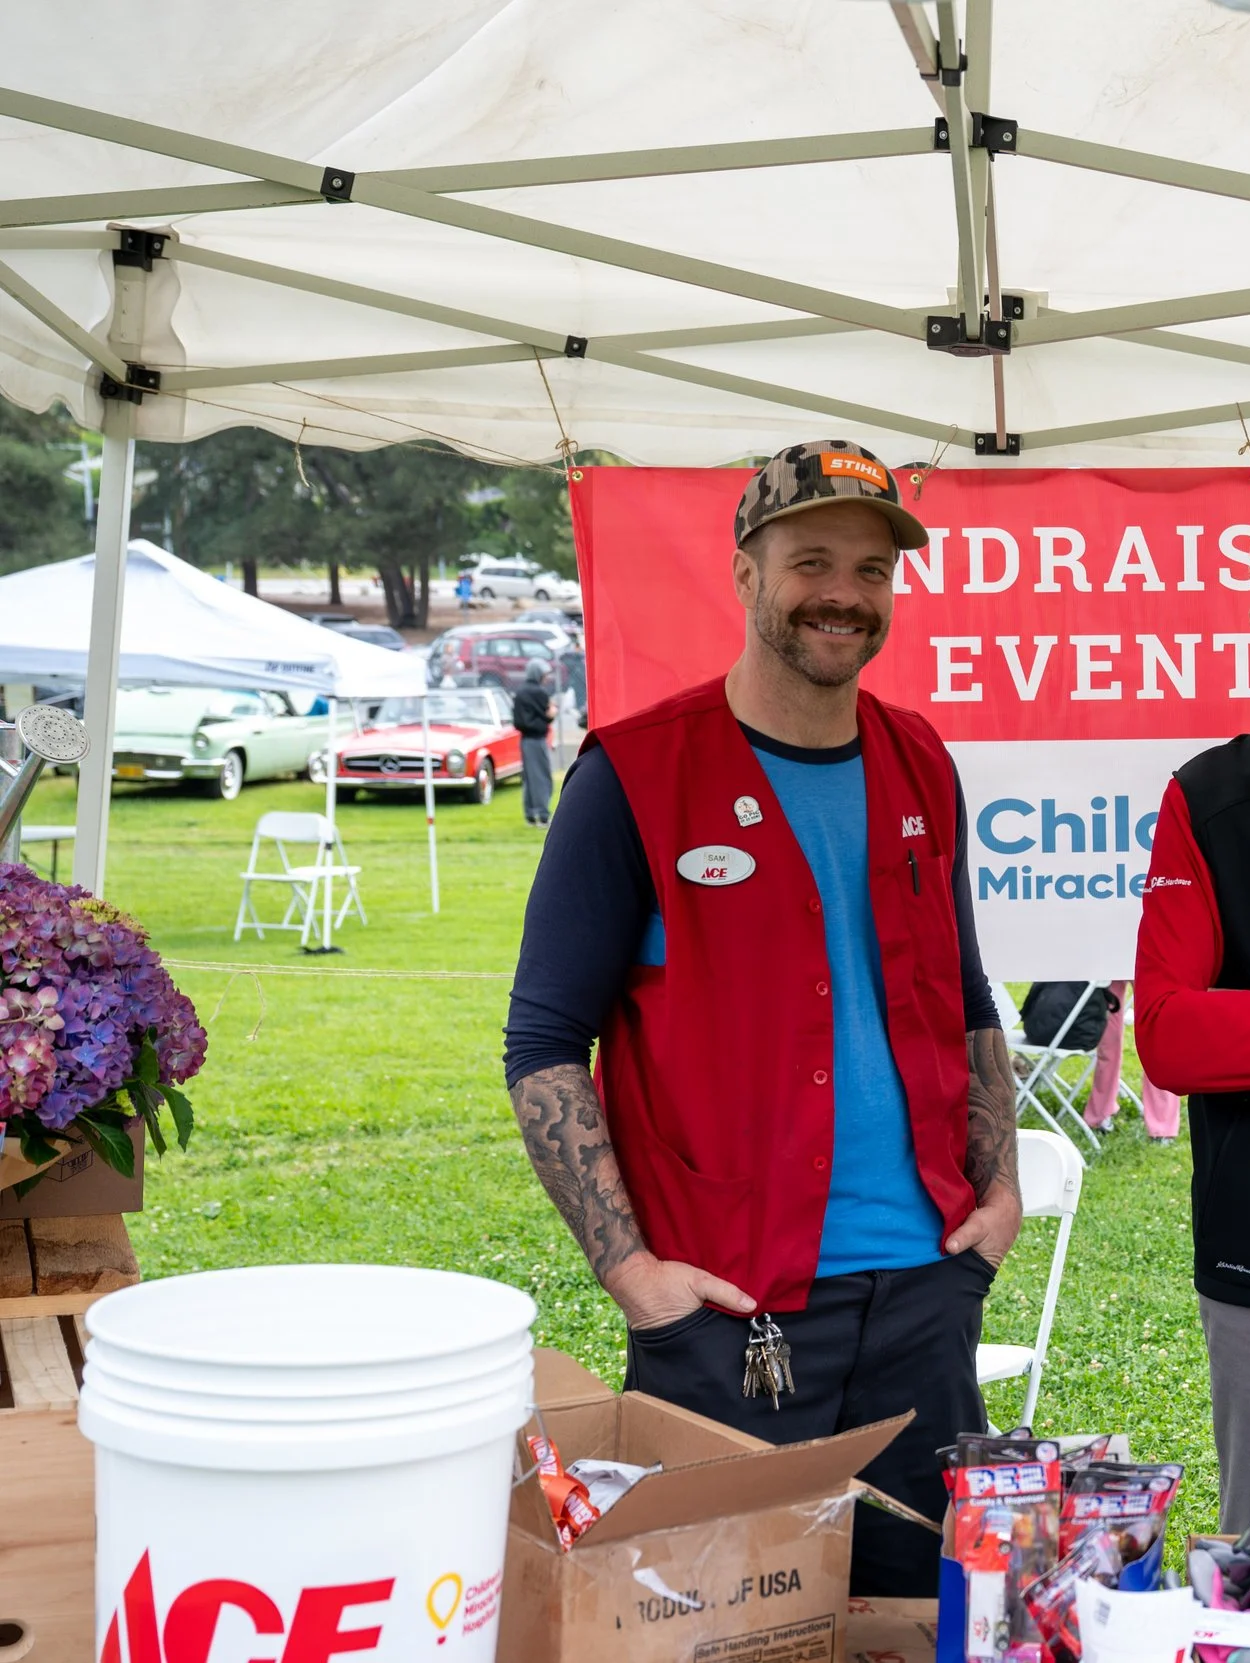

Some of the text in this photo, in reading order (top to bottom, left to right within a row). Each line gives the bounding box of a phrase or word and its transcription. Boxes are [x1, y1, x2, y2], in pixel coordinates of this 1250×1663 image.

[830, 458, 882, 480] STIHL
[902, 815, 926, 838] ACE
[708, 854, 726, 862] SAM
[701, 867, 727, 879] ACE
[965, 1463, 1048, 1497] PEZ
[1073, 1494, 1153, 1518] PEZ
[760, 1568, 802, 1598] USA
[100, 1546, 396, 1663] ACE
[724, 1633, 770, 1653] Handling
[773, 1620, 832, 1642] Instructions
